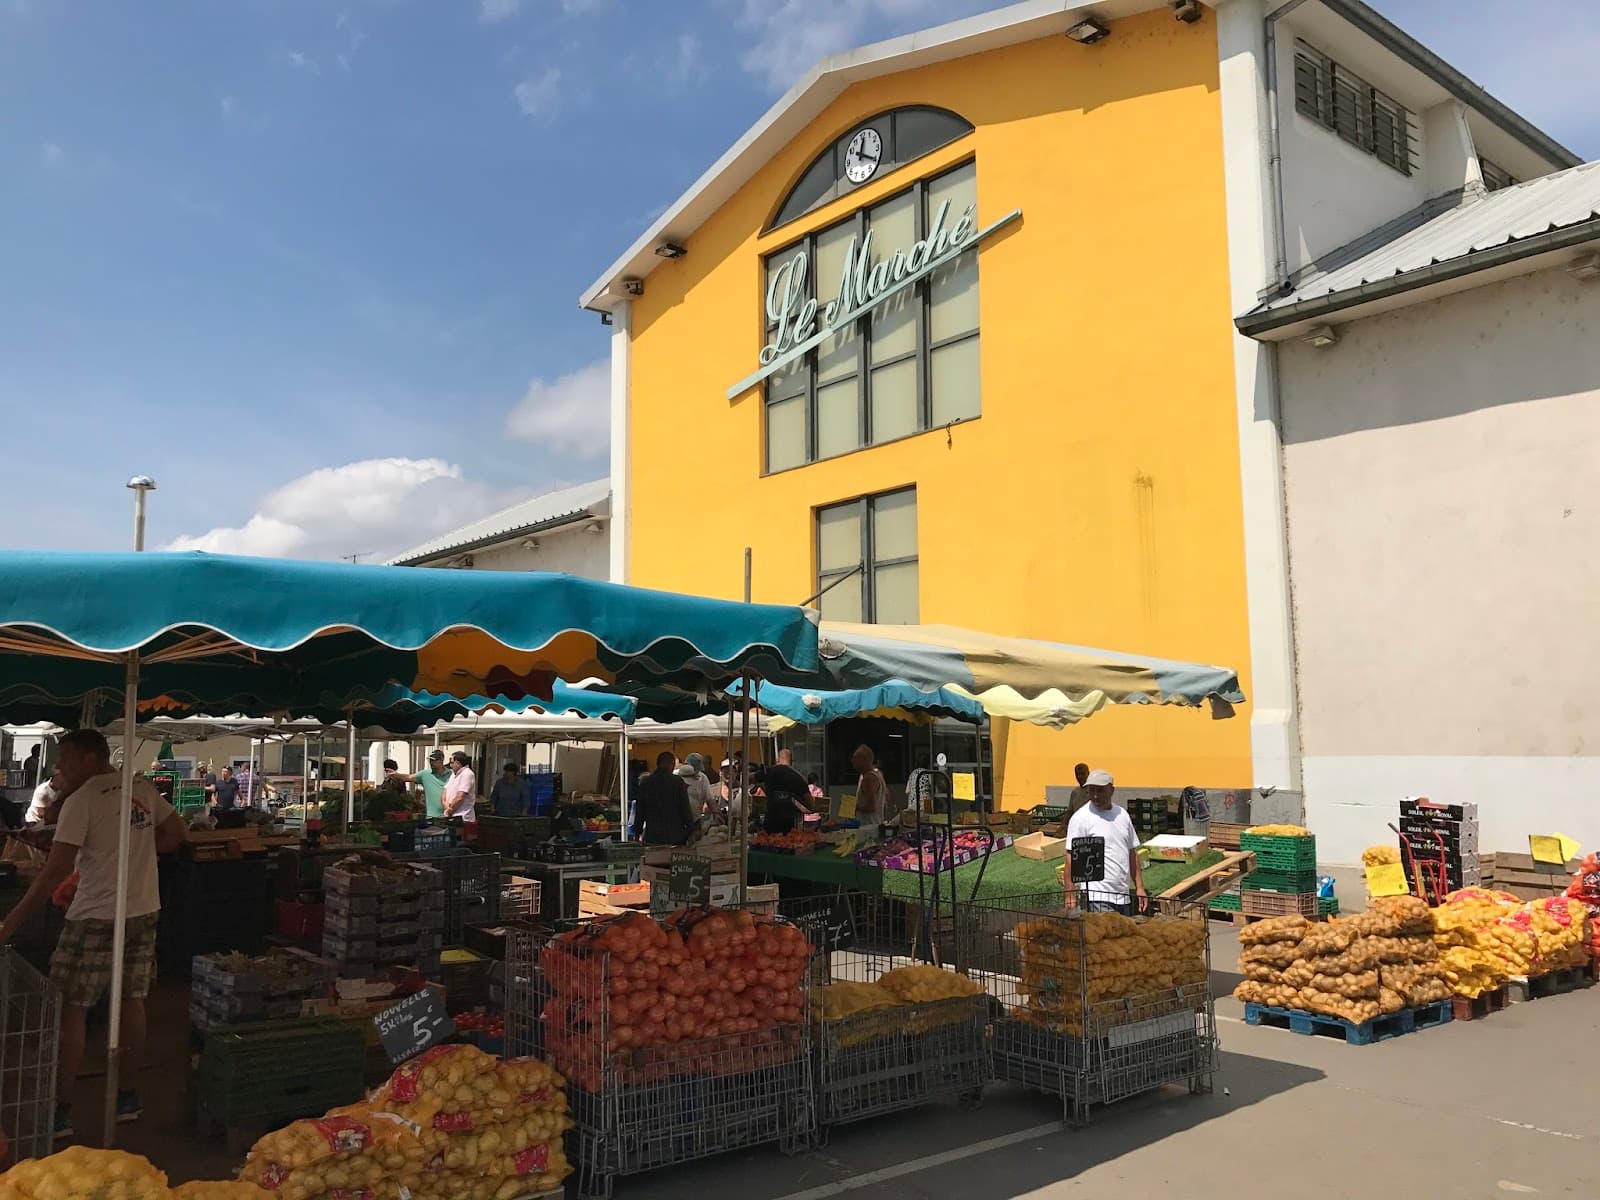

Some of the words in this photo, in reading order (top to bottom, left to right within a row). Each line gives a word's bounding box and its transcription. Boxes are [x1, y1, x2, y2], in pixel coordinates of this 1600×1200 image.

[760, 252, 817, 365] Le
[825, 198, 976, 327] Marché
[374, 988, 430, 1025] NOUVELLE
